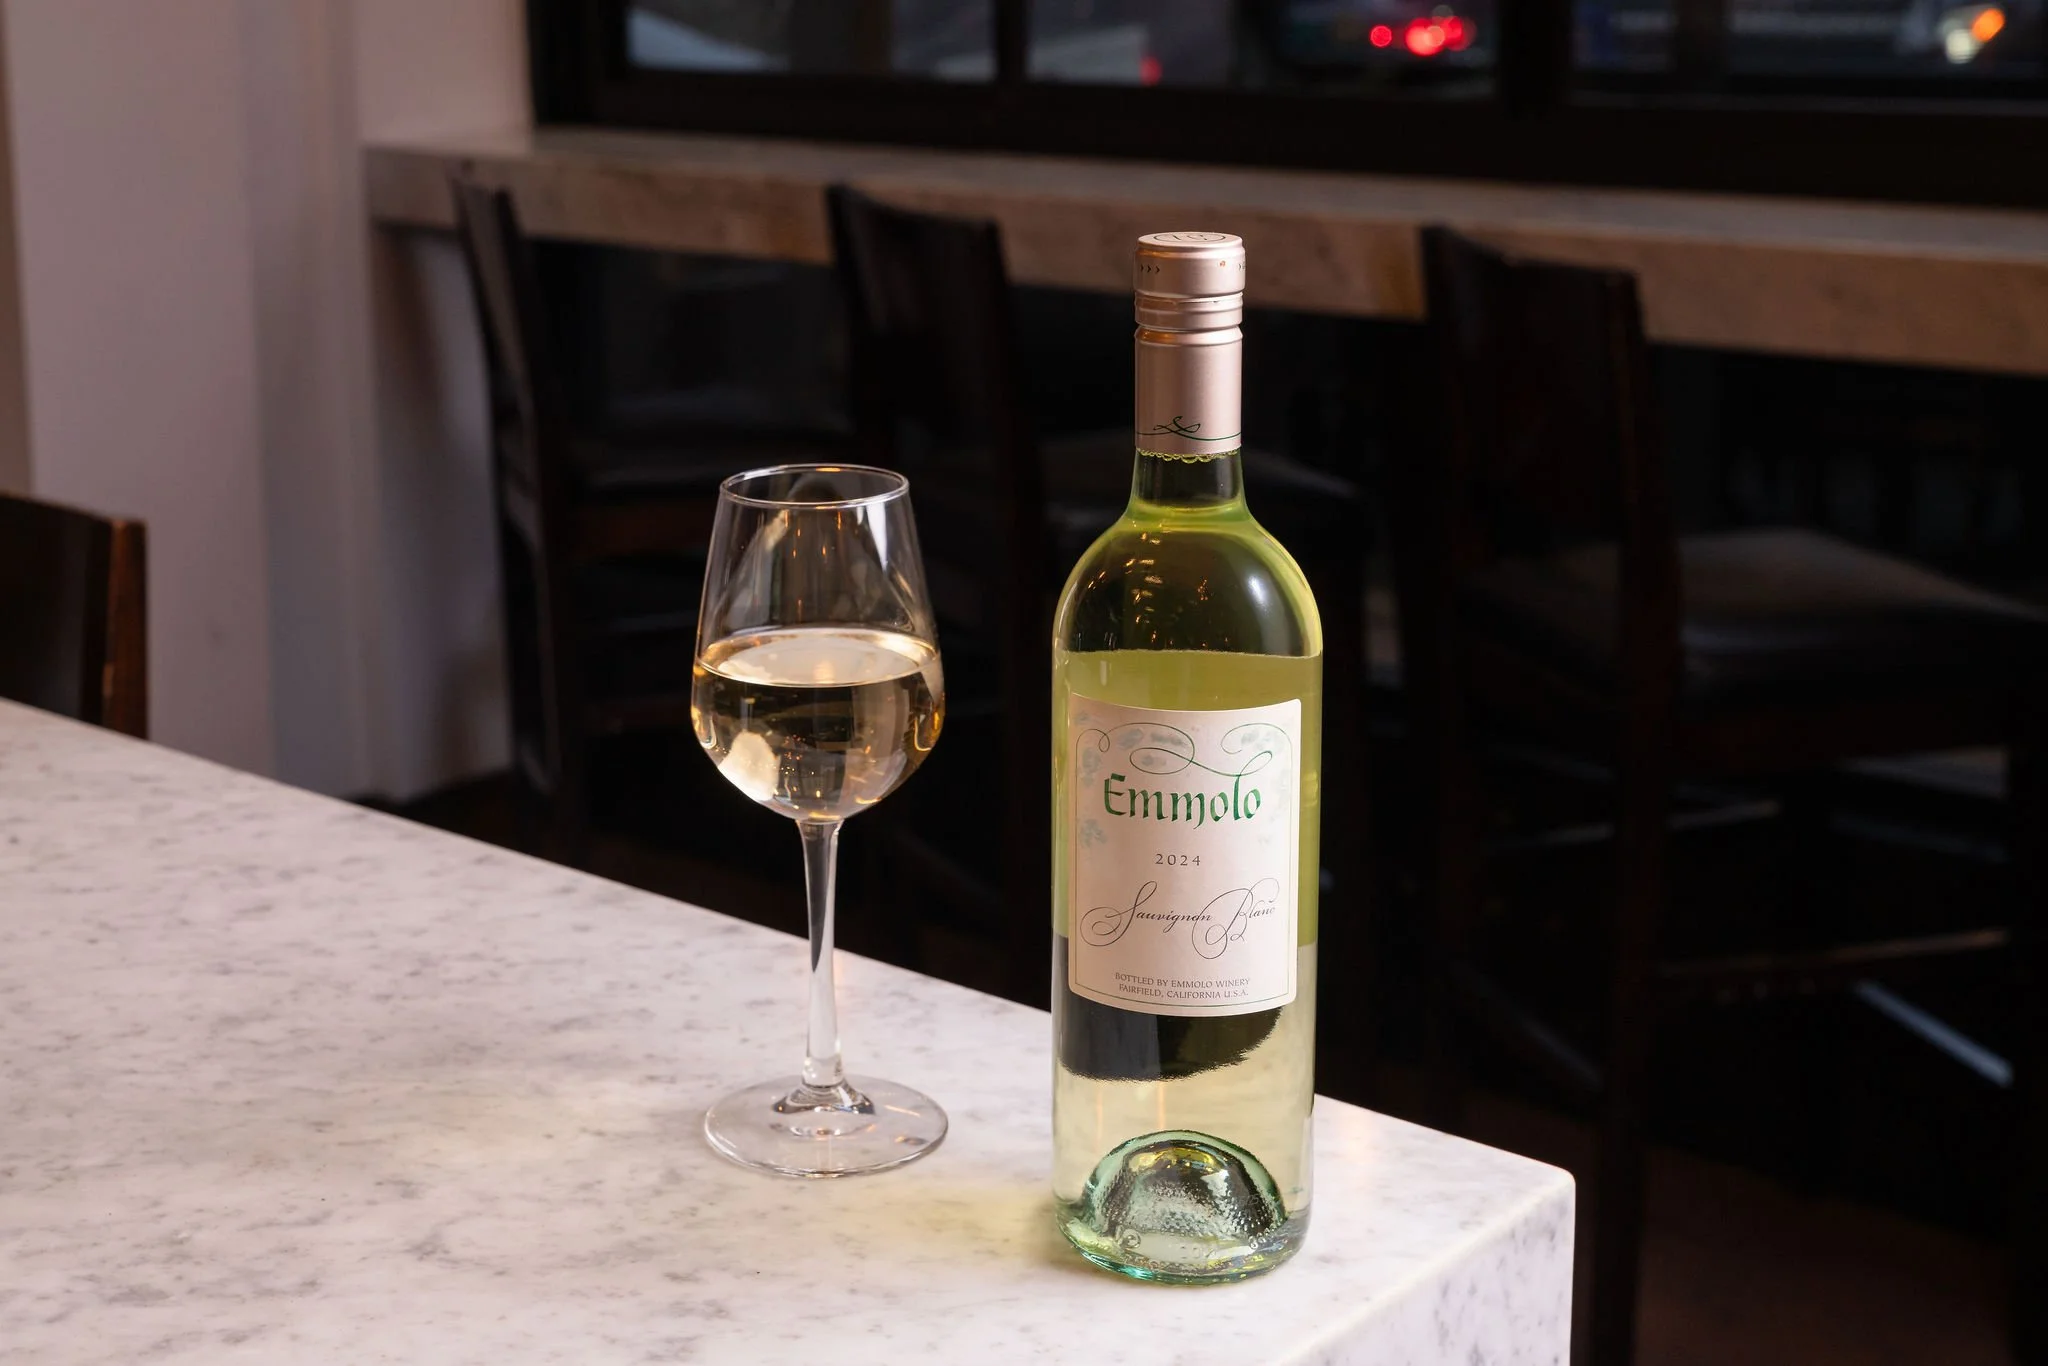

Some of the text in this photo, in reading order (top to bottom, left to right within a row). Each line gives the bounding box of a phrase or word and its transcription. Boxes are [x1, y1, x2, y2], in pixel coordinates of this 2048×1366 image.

[1103, 772, 1261, 830] Emmolo
[1155, 853, 1201, 867] 2024
[1079, 877, 1280, 960] Sauvignon Blanc
[1115, 972, 1251, 989] BOTTLED BY EMMOLO WINERY
[1119, 983, 1249, 999] FAIRFIELD, CALIFORNIA U.S.A.
